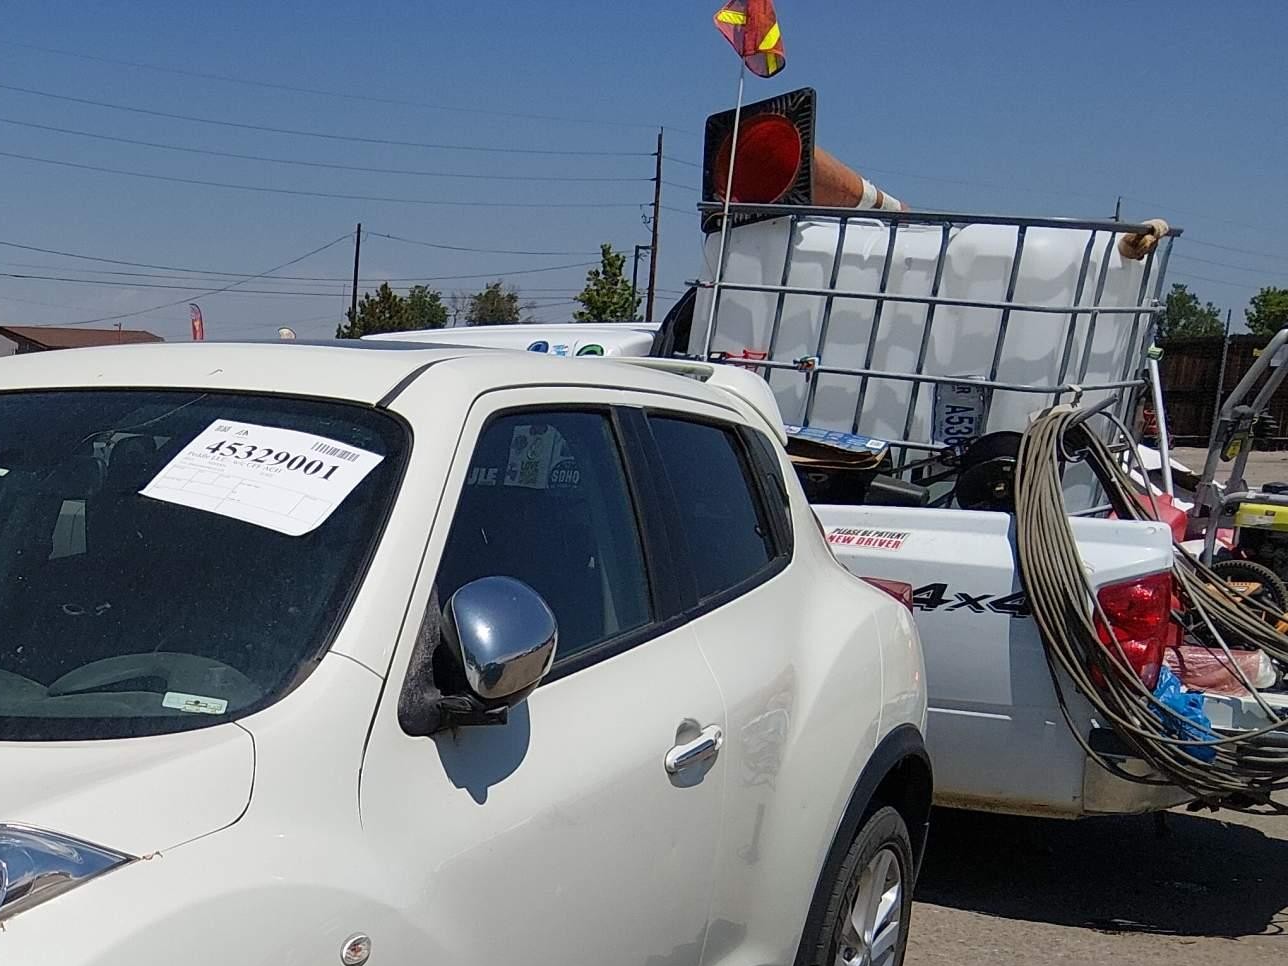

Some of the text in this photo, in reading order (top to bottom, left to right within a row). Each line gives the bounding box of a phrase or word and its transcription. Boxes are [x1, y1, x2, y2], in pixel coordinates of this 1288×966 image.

[205, 439, 340, 481] 45329001
[832, 527, 910, 540] PLEASE BE PATIENT
[828, 534, 902, 550] NEW DRIVER
